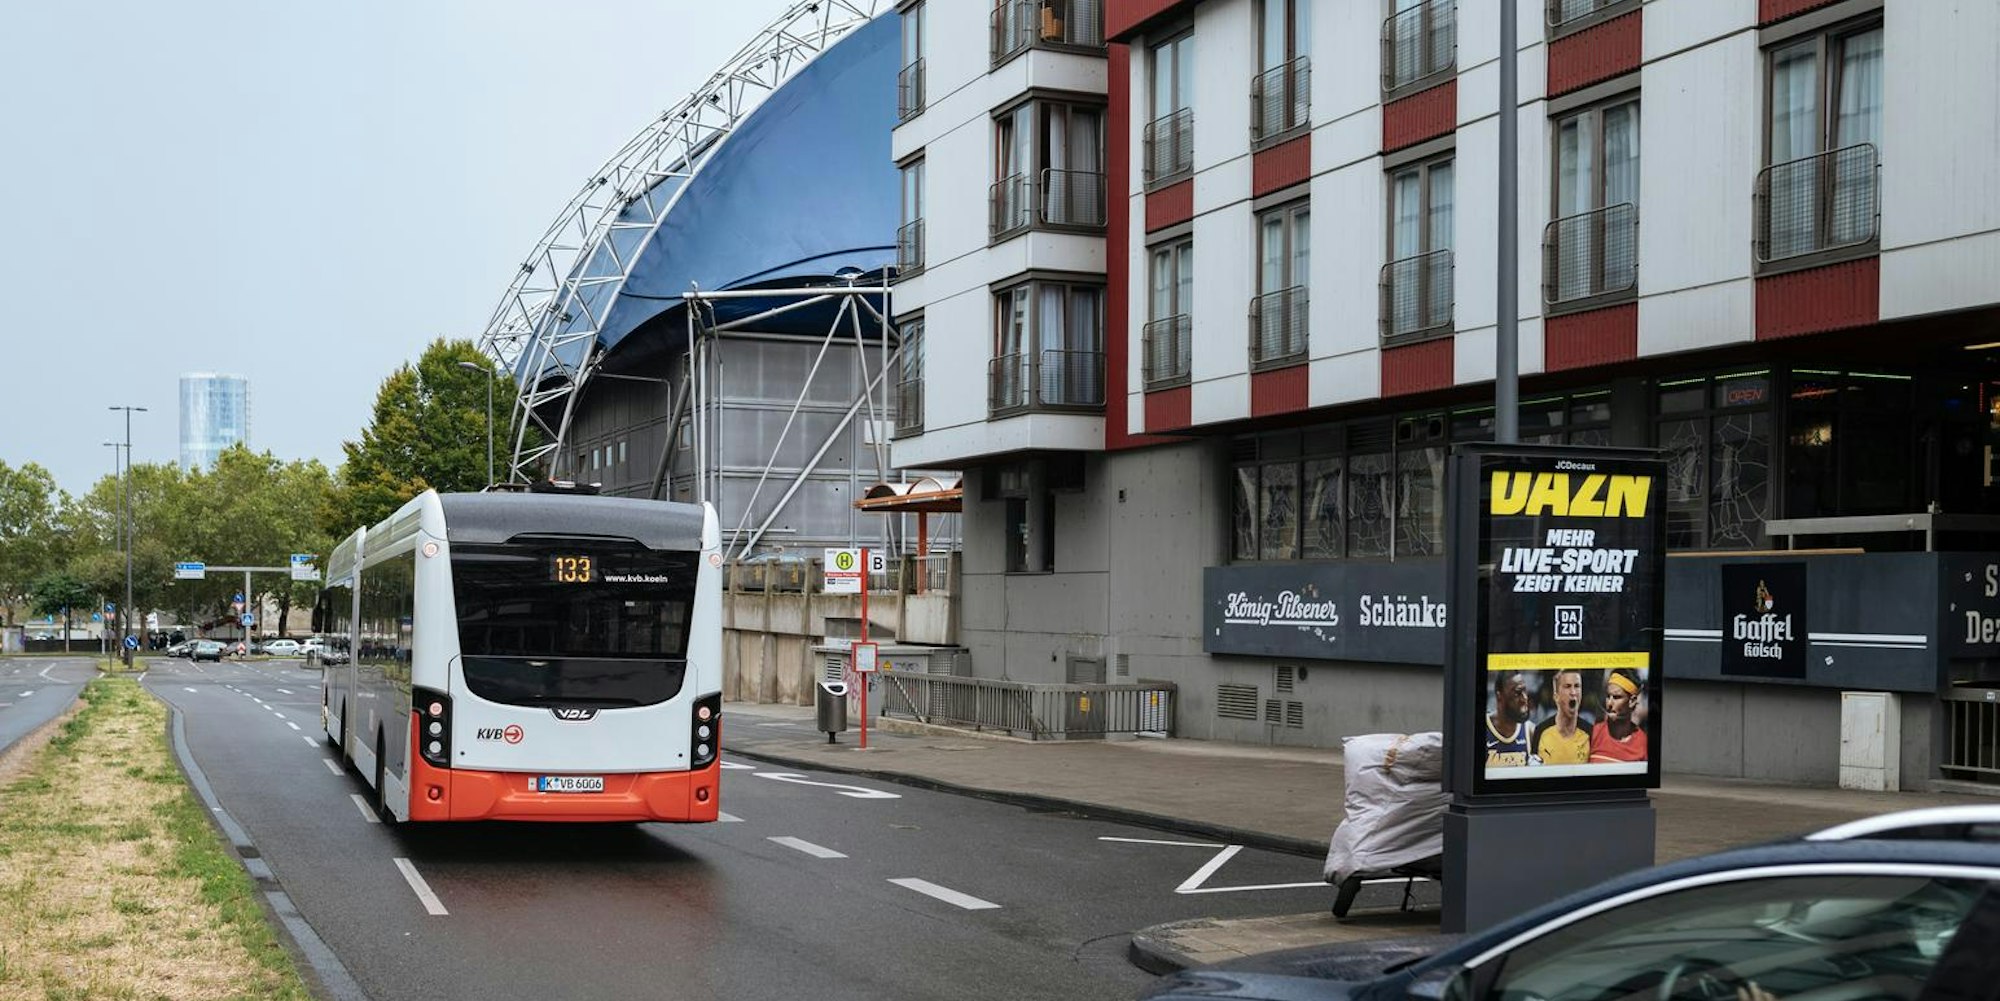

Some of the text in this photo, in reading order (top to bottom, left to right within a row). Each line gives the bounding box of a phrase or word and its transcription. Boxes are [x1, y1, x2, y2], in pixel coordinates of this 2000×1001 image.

[1555, 461, 1596, 471] JCDecaux
[1546, 529, 1596, 547] MEHR
[840, 556, 849, 567] H
[873, 557, 883, 570] B
[1500, 548, 1639, 574] LIVE-SPORT
[556, 556, 592, 583] 133
[604, 574, 668, 584] www.kvb.koeln
[1513, 575, 1624, 593] ZEIGT KEINER
[1224, 591, 1339, 627] König-Pilsener
[1360, 595, 1447, 628] Schänke
[1561, 611, 1577, 622] DA
[1561, 623, 1577, 634] ZN
[1733, 613, 1794, 643] Gaffel
[557, 708, 592, 719] VDL
[477, 728, 503, 740] KVB
[545, 779, 602, 789] K VB 6006
